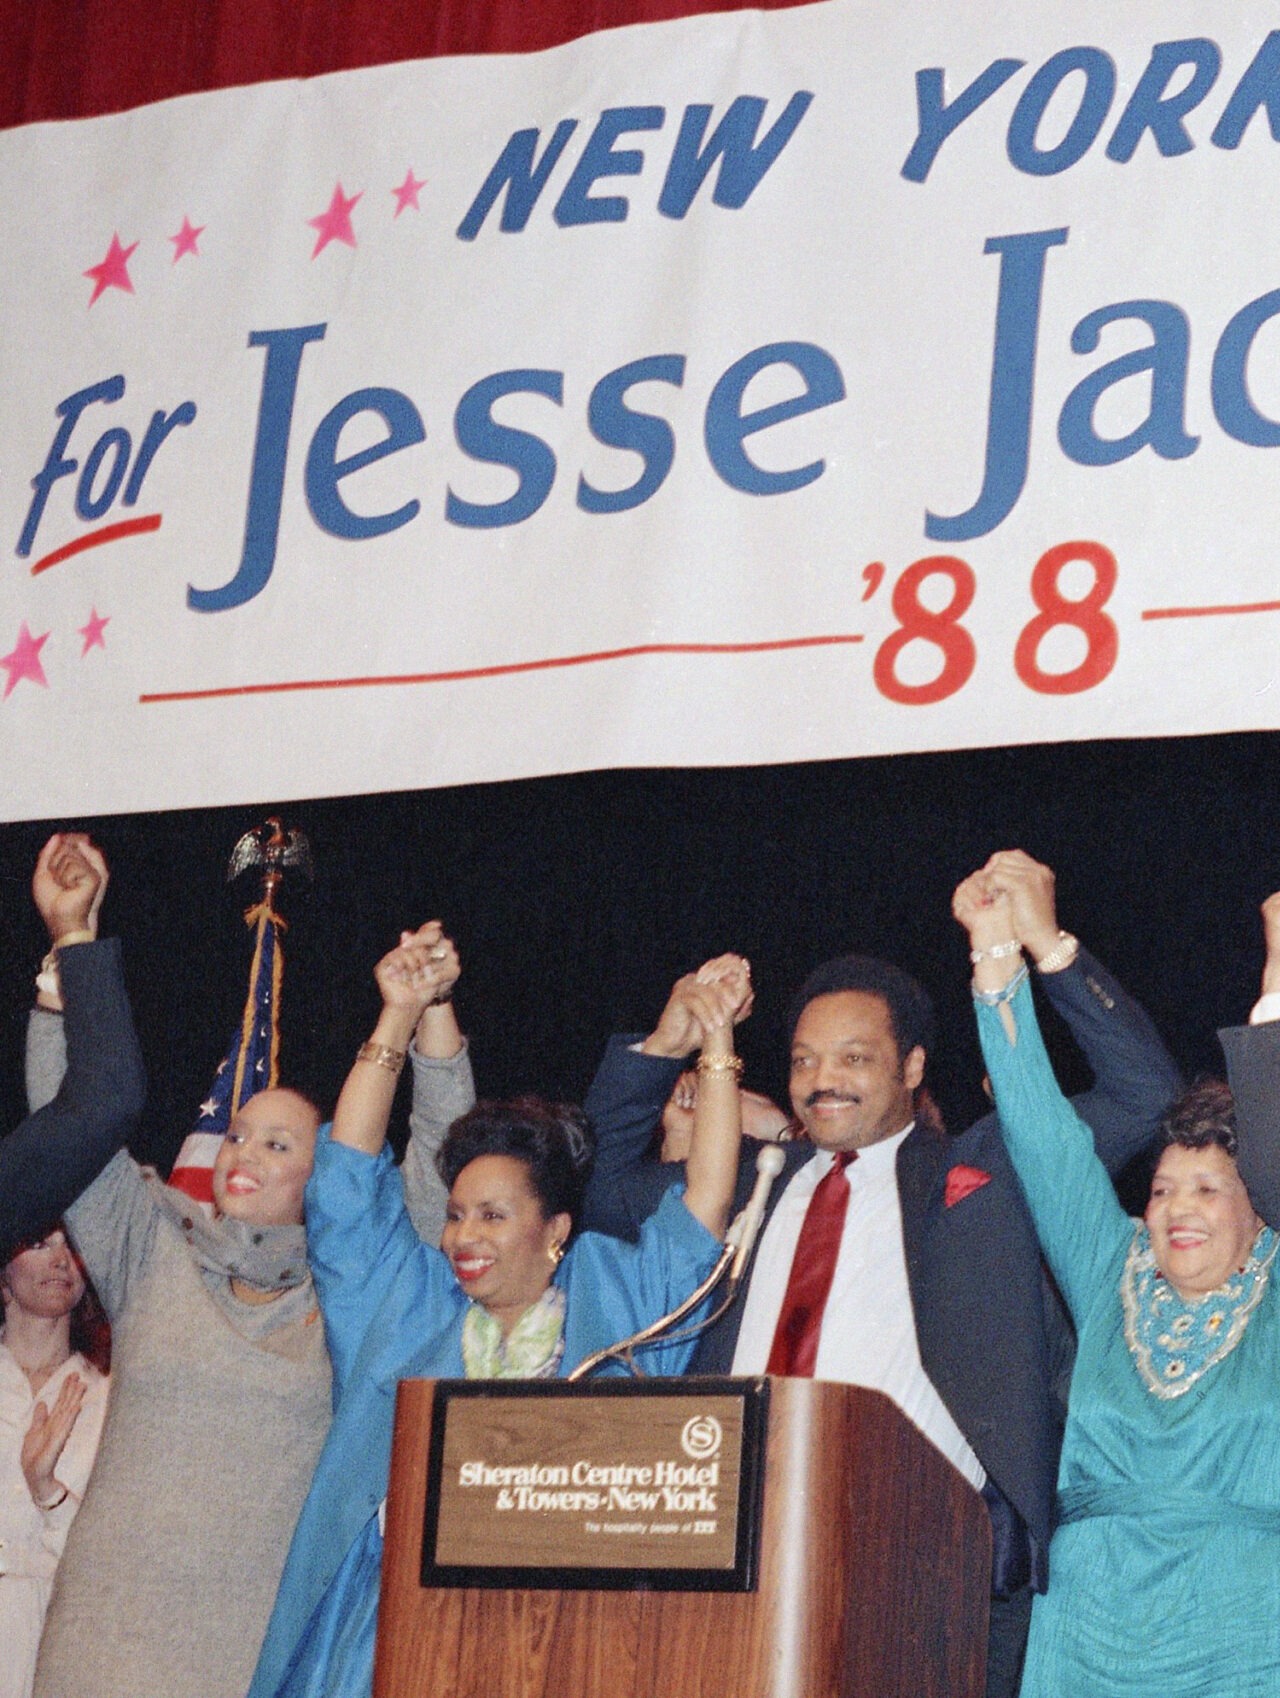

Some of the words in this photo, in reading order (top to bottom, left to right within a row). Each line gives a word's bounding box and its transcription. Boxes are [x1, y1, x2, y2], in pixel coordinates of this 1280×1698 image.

[457, 91, 814, 241] NEW
[17, 375, 196, 557] For
[188, 323, 845, 613] Jesse
[862, 541, 1119, 706] '88
[459, 1462, 570, 1486] Sheraton
[571, 1461, 651, 1486] Centre
[653, 1462, 719, 1486] Hotel
[660, 1488, 718, 1511] York
